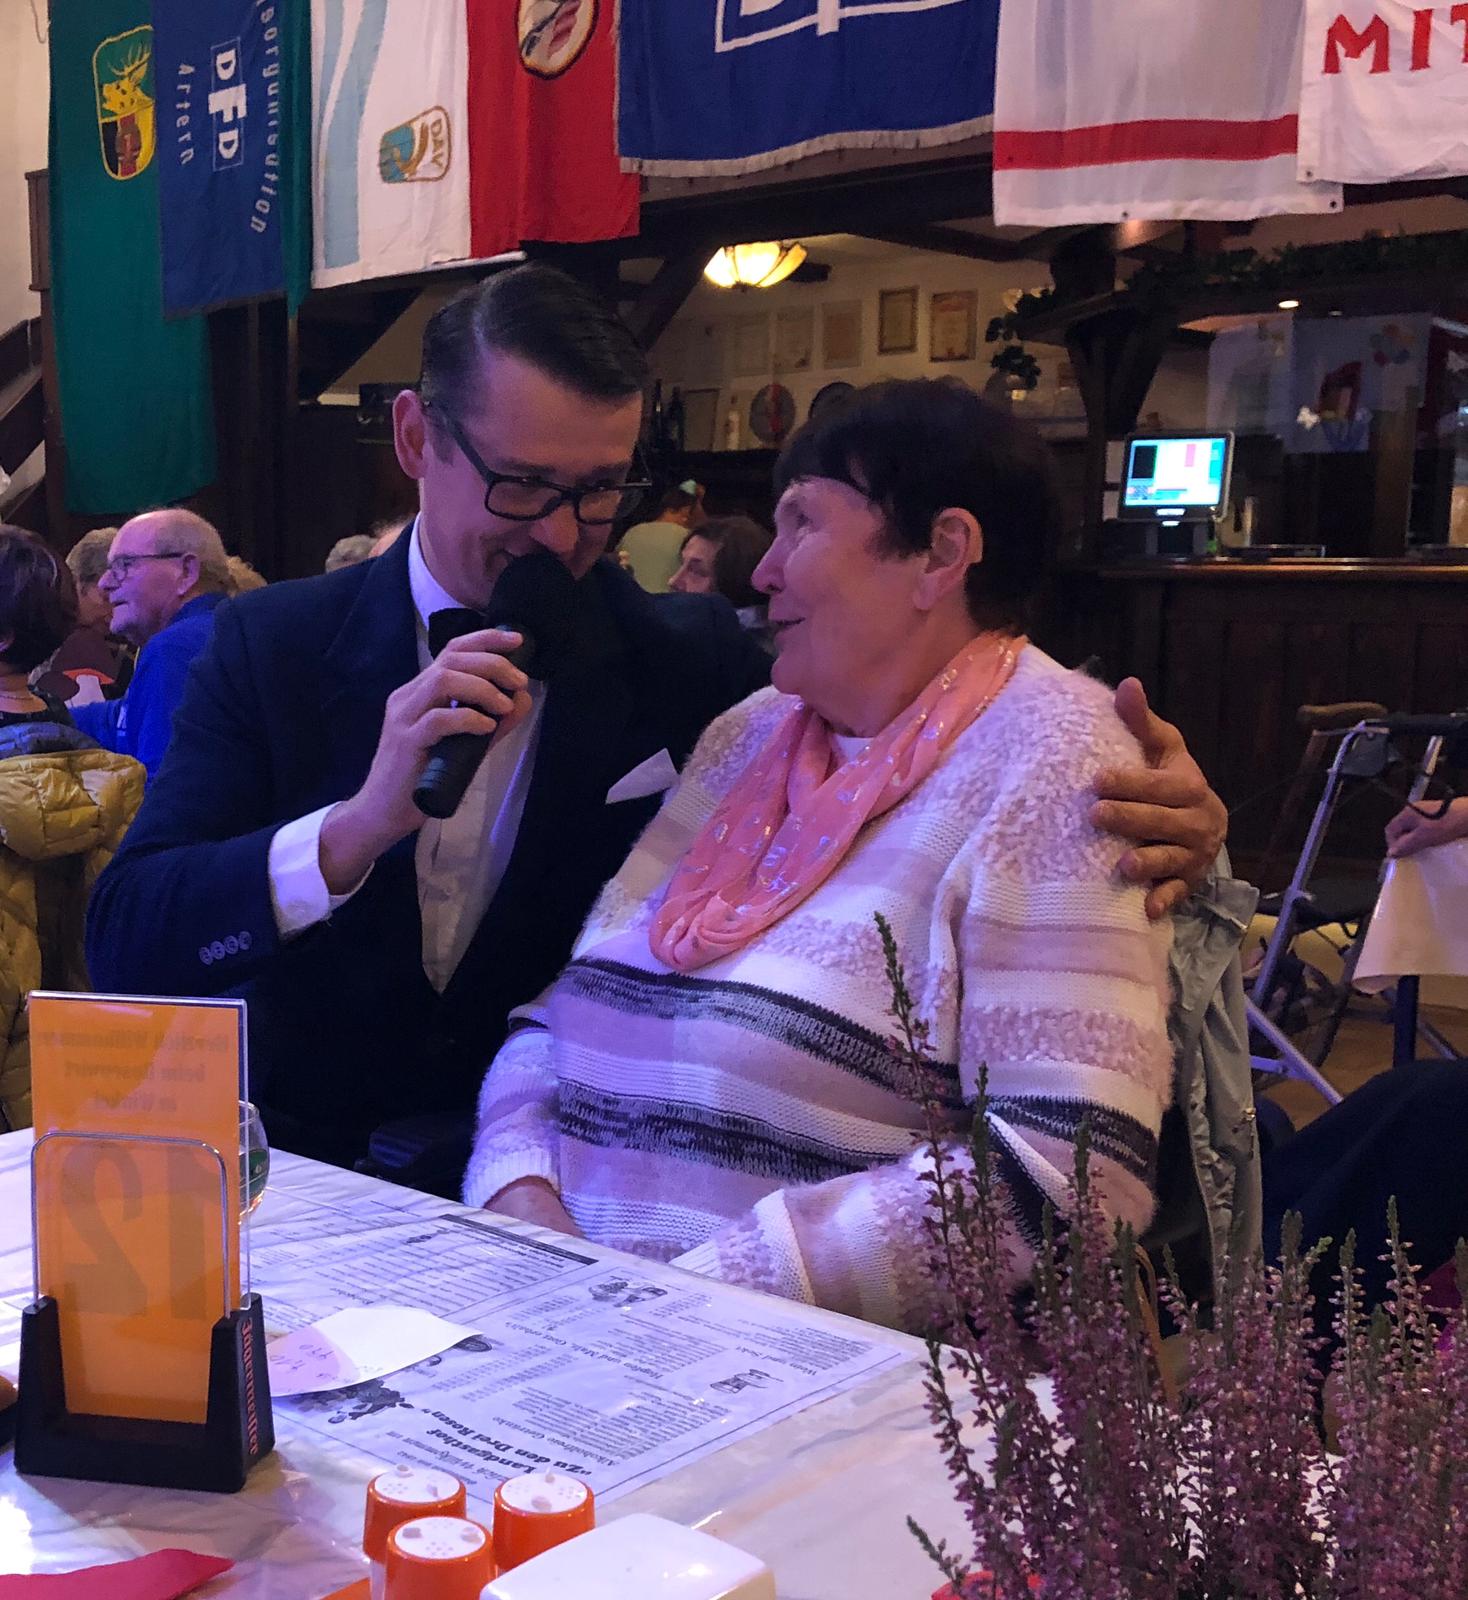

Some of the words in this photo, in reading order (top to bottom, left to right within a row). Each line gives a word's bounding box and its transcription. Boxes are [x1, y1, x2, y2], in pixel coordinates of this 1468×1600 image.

[176, 63, 195, 165] Artern
[208, 48, 247, 160] DFD
[251, 0, 280, 233] sorganisation
[430, 118, 444, 169] DAV
[241, 1318, 259, 1455] Jägermeister
[426, 1428, 537, 1474] Landgasthof
[471, 1433, 514, 1453] Drei
[515, 1449, 551, 1463] den
